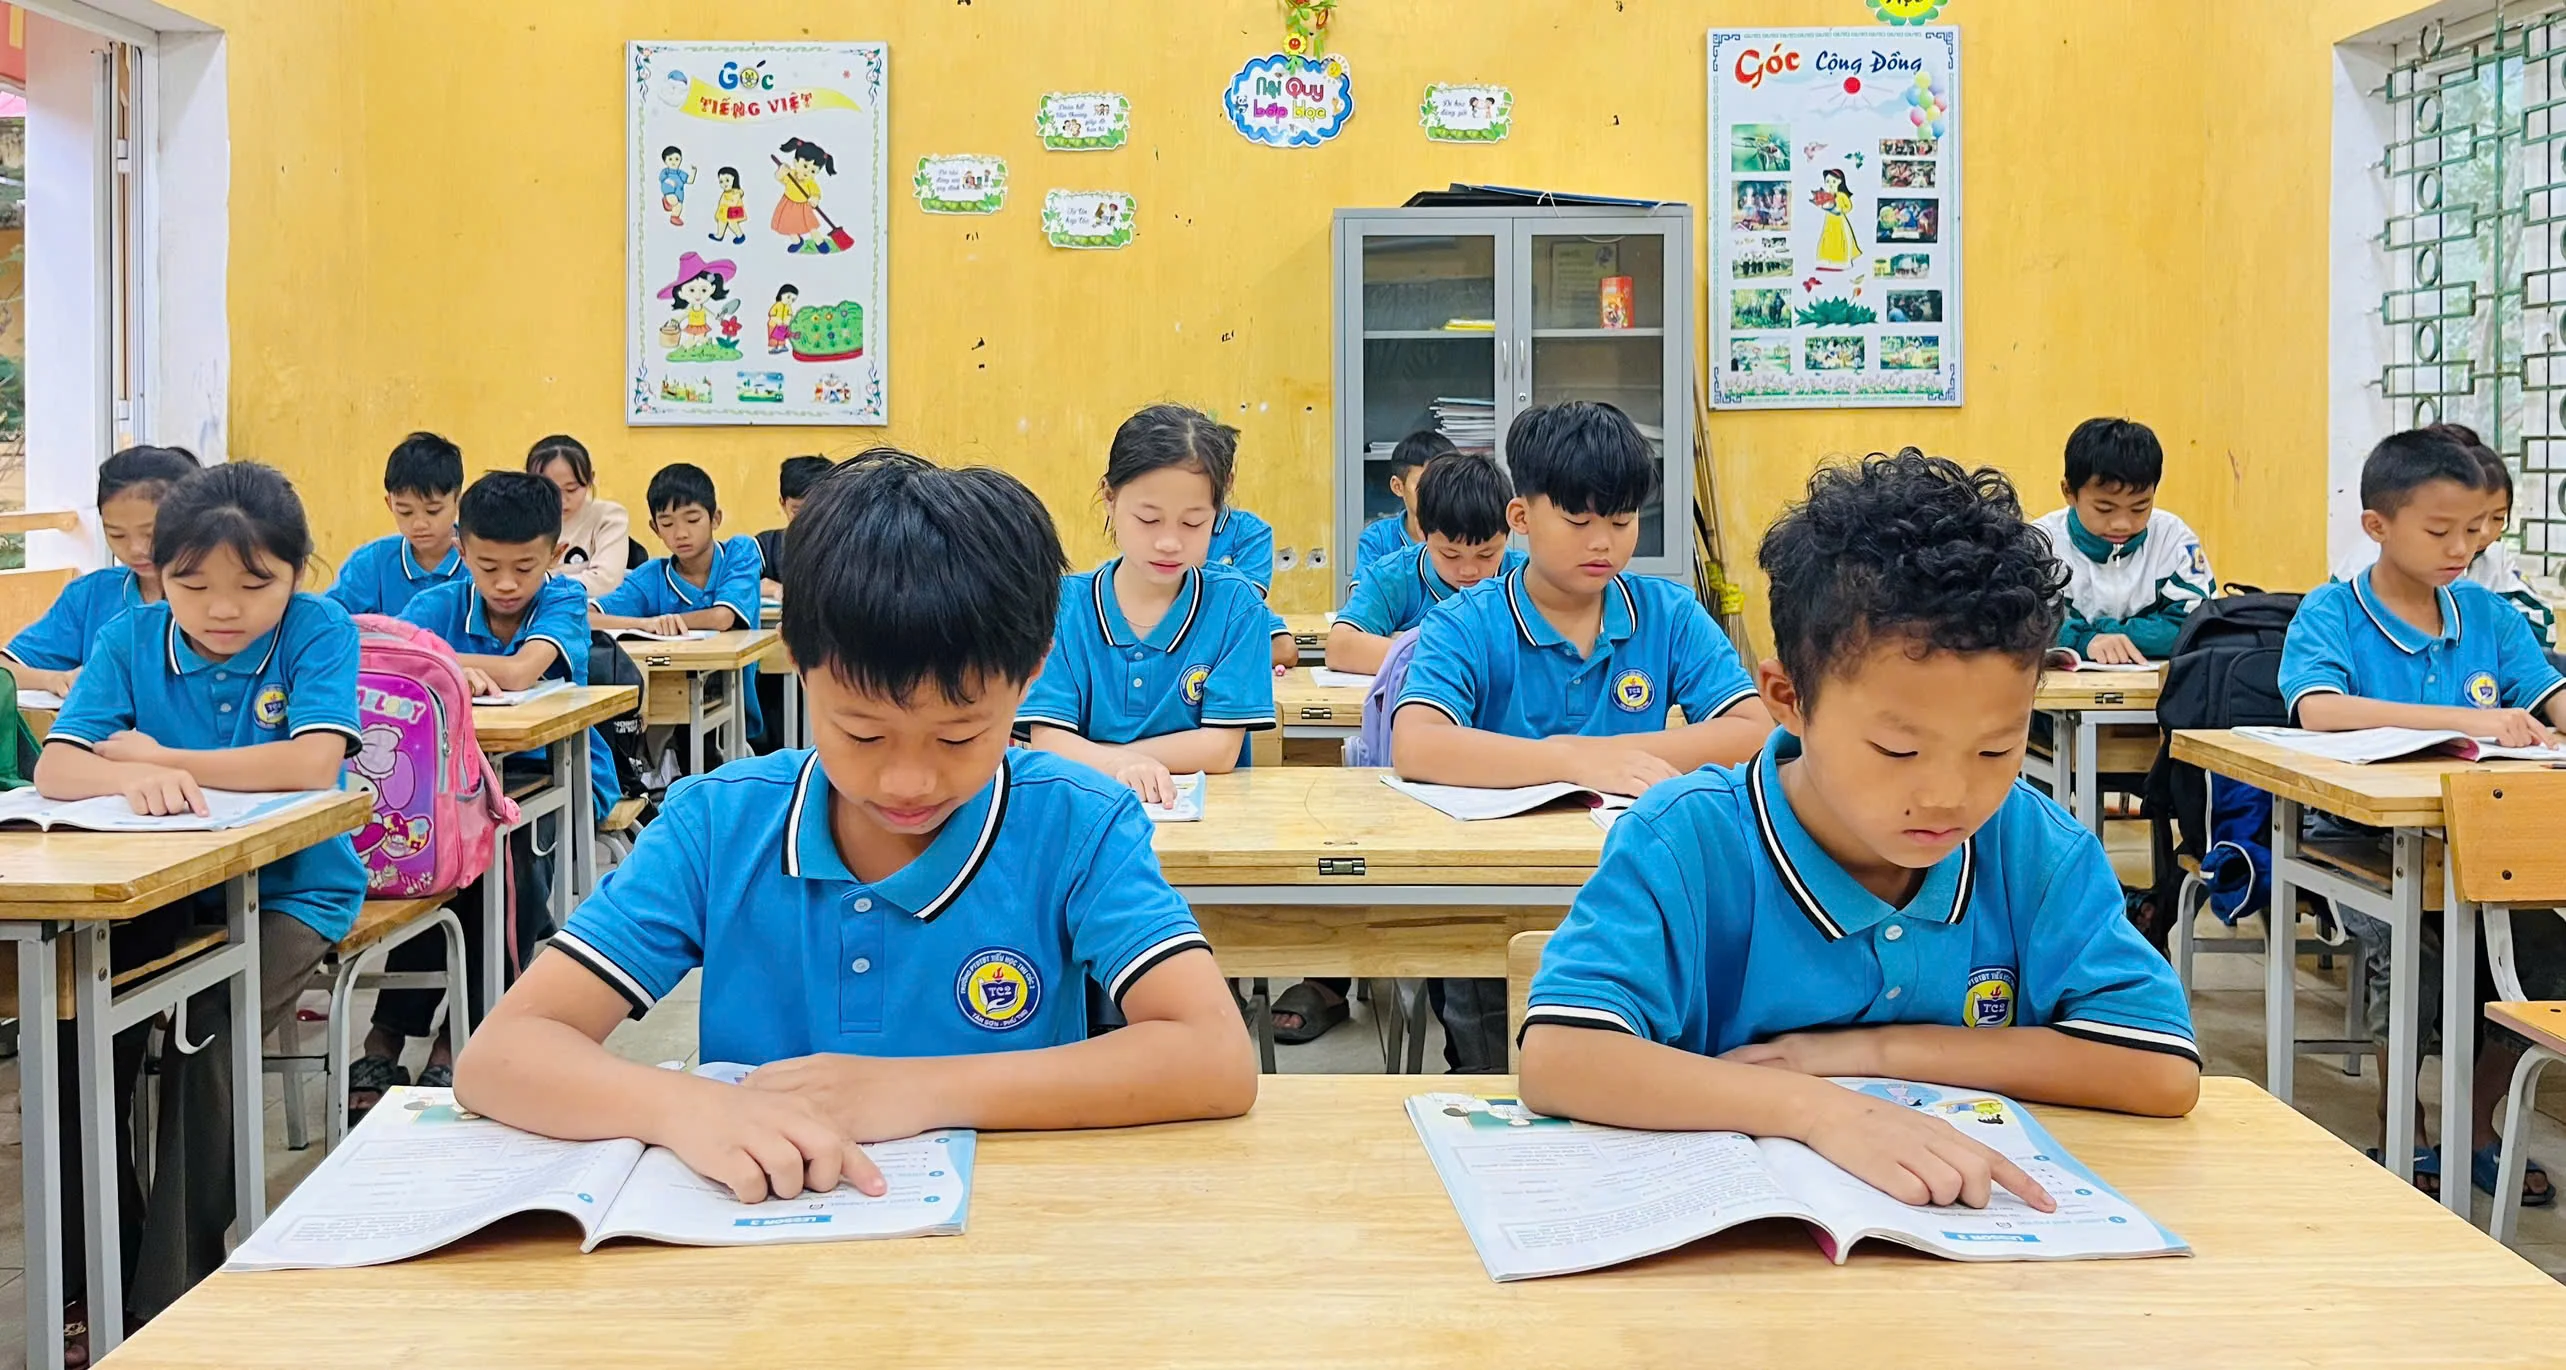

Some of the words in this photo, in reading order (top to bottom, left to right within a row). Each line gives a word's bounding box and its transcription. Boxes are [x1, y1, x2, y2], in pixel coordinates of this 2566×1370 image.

[1735, 43, 1800, 89] Góc
[1815, 50, 1862, 75] Cộng
[1869, 50, 1922, 75] Đồng
[1285, 77, 1324, 102] Quy
[700, 96, 760, 119] TIẾNG
[767, 92, 812, 114] VIỆT
[988, 986, 1012, 997] TC2
